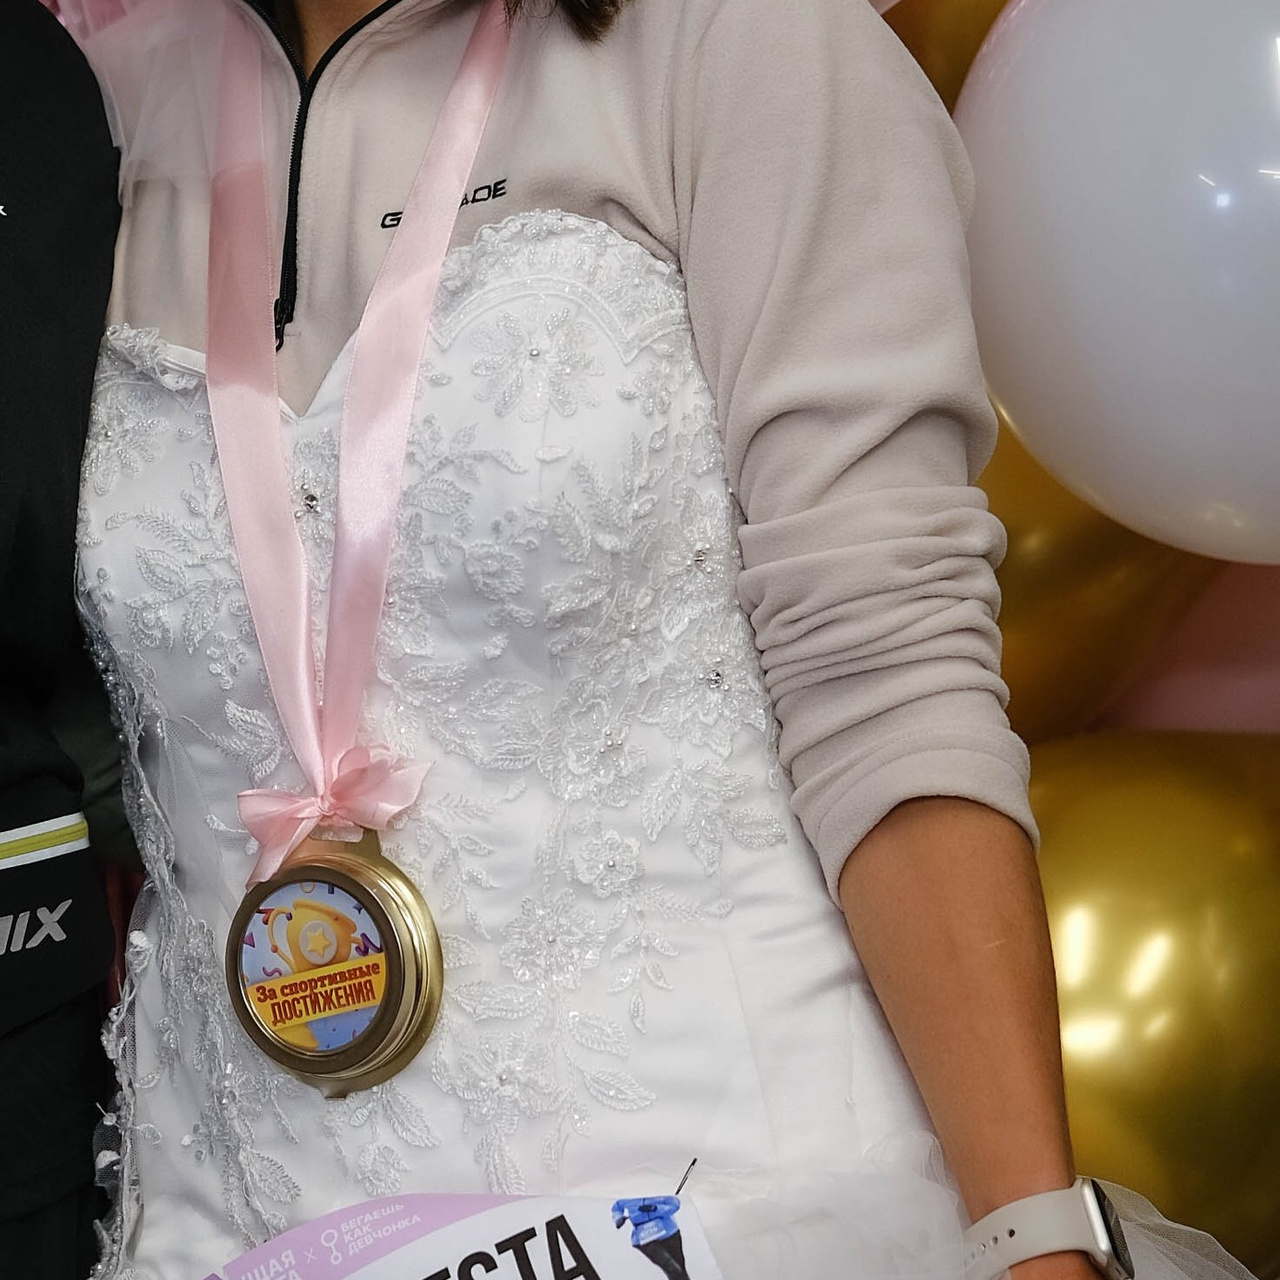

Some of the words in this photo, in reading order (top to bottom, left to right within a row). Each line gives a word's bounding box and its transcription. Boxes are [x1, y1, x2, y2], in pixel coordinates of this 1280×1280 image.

[256, 985, 278, 1003] За
[280, 962, 380, 997] спортивные
[271, 978, 376, 1026] ДОСТИЖЕНИЯ
[340, 1203, 405, 1233] БЕГАЕШЬ
[343, 1222, 373, 1245] КАК
[348, 1213, 422, 1257] ДЕВЧОНКА
